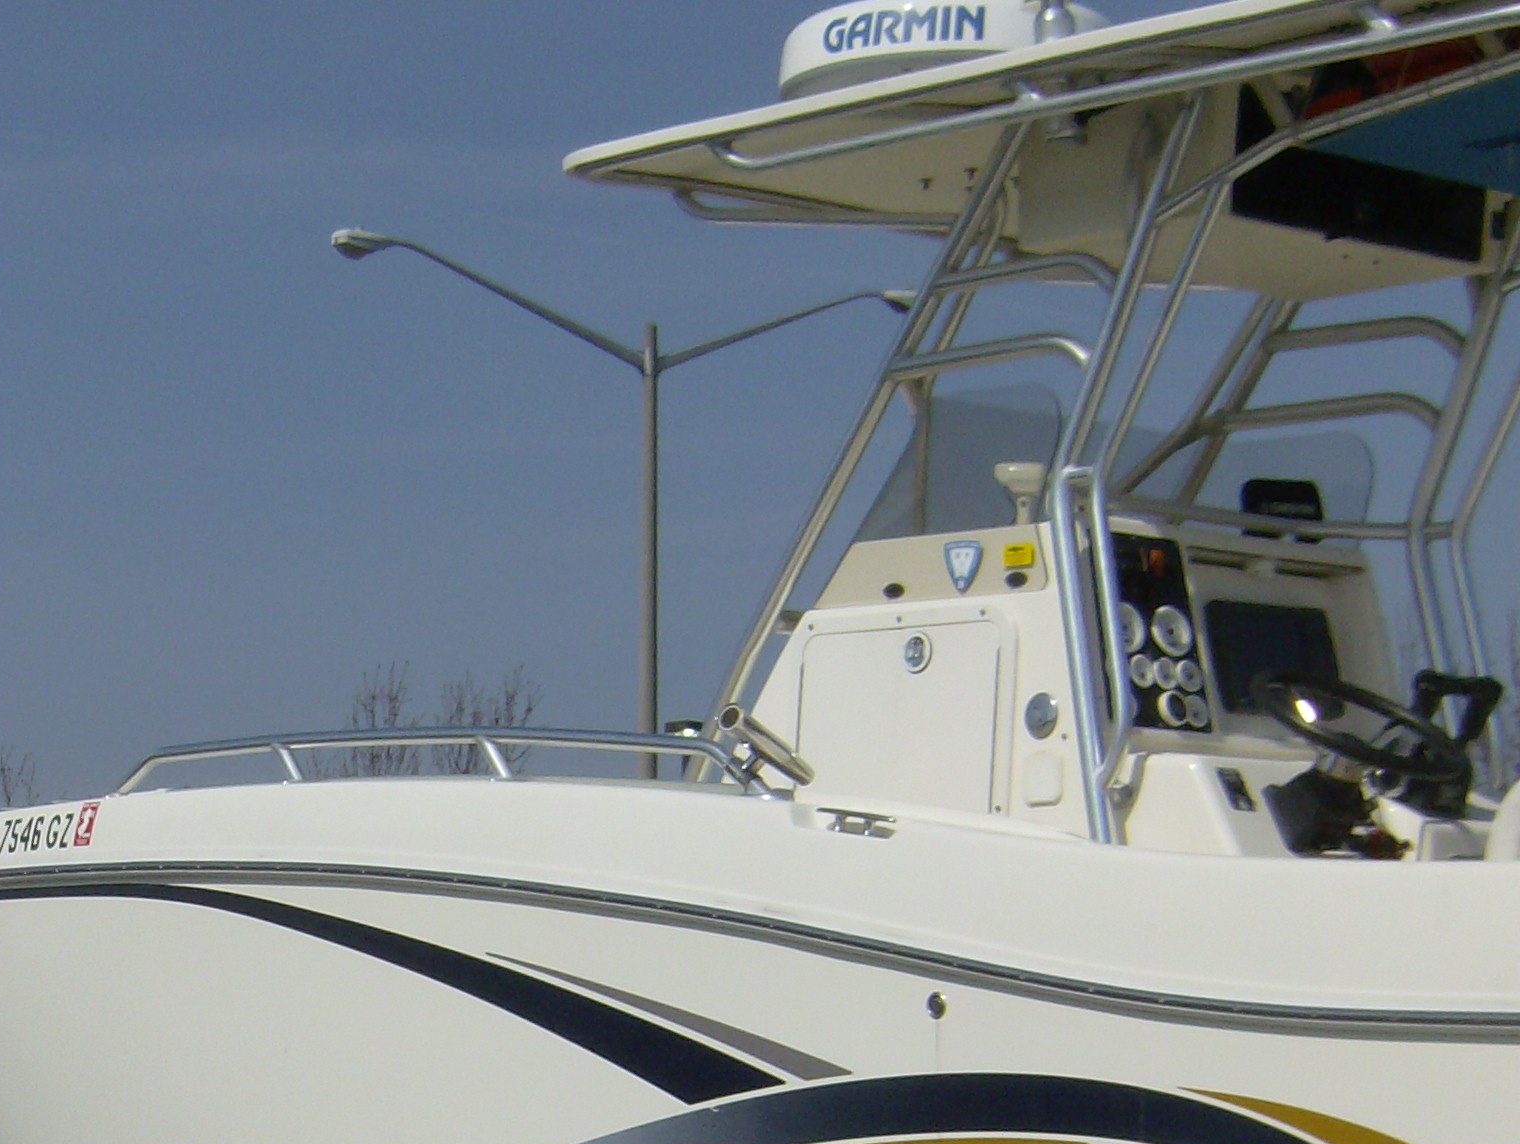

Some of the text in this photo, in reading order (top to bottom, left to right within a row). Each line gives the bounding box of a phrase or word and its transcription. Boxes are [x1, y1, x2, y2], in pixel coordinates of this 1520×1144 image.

[824, 7, 985, 53] GARMIN
[0, 816, 44, 854] 7546
[46, 814, 73, 848] GZ
